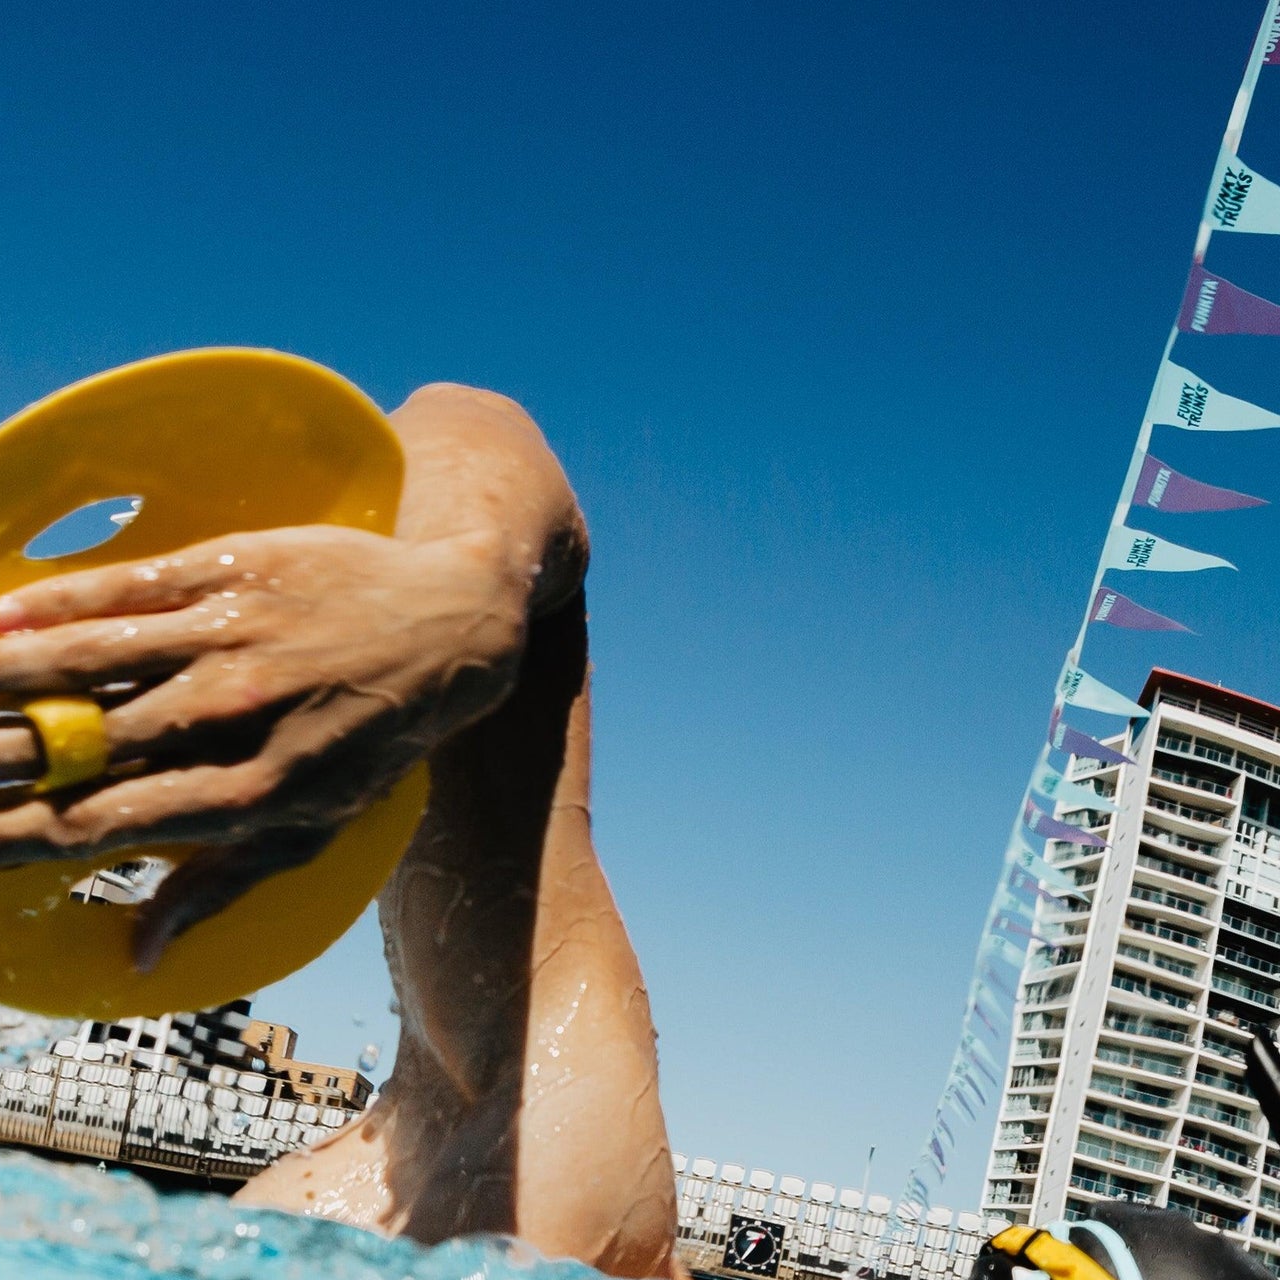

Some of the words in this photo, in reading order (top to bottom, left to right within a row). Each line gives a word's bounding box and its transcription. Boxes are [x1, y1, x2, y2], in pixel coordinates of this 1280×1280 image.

[1212, 166, 1238, 221] FUNKY
[1221, 171, 1253, 227] TRUNKS
[1191, 279, 1219, 332] FUNKITA
[1177, 382, 1195, 420] FUNKY
[1188, 384, 1209, 427] TRUNKS
[1127, 538, 1145, 563] FUNKY
[1136, 538, 1156, 567] TRUNKS
